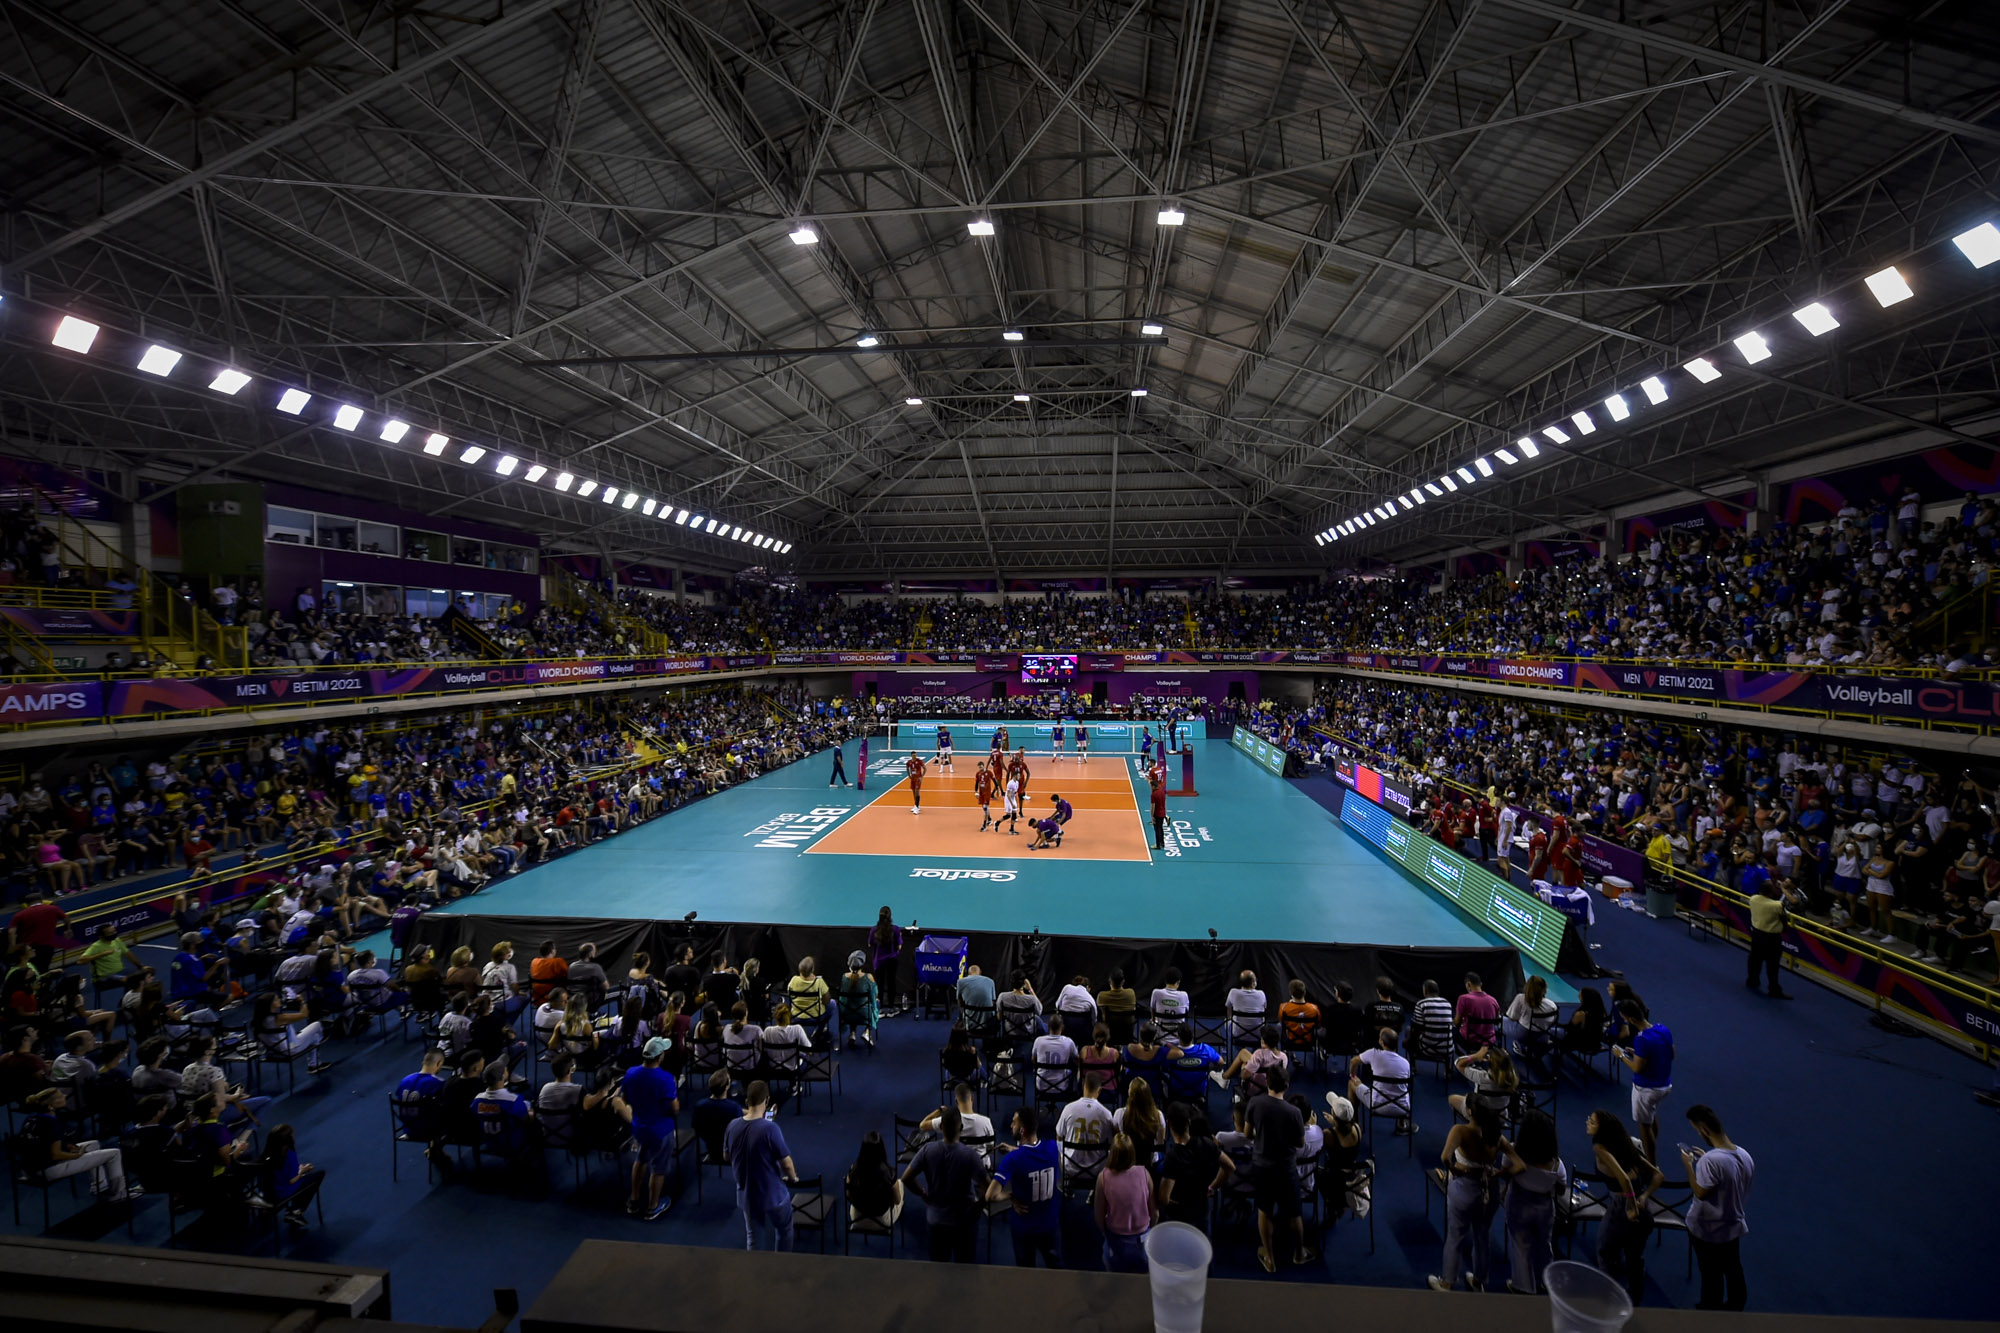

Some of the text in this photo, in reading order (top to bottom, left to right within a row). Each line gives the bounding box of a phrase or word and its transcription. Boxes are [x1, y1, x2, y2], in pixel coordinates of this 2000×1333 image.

[664, 661, 684, 670] WORLD
[684, 660, 705, 669] CHAMPS
[1499, 664, 1526, 676] WORLD
[1526, 667, 1563, 679] CHAMPS
[444, 665, 604, 685] Volleyball CLUB WORLD CHAMPS
[1623, 673, 1715, 690] MEN BETIM 2021
[236, 678, 363, 697] MEN BETIM 2021
[1144, 687, 1192, 696] CLUB
[1826, 684, 1912, 707] Volleyball
[753, 807, 851, 848] BETIM
[1172, 820, 1201, 847] CLUB
[909, 868, 1018, 882] Gerflor
[120, 910, 151, 926] 2021
[1028, 1167, 1054, 1203] 10
